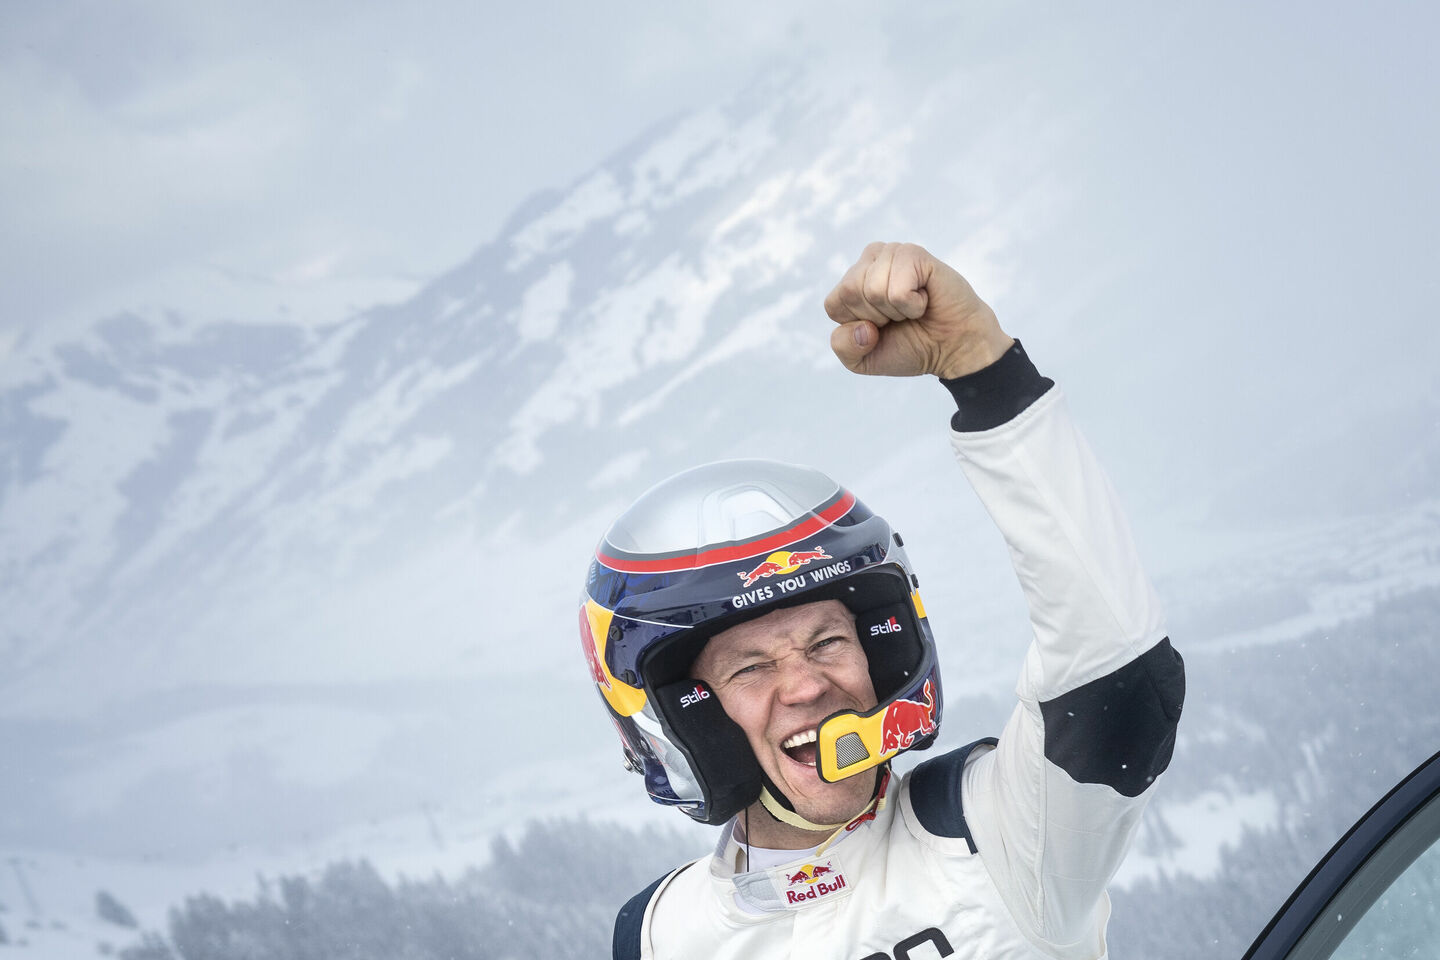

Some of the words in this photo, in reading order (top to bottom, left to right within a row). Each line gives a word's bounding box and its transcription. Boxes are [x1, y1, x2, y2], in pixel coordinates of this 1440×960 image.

[732, 586, 774, 609] GIVES
[776, 575, 806, 594] YOU
[811, 560, 851, 583] WINGS
[786, 885, 817, 904] Red
[817, 874, 846, 896] Bull
